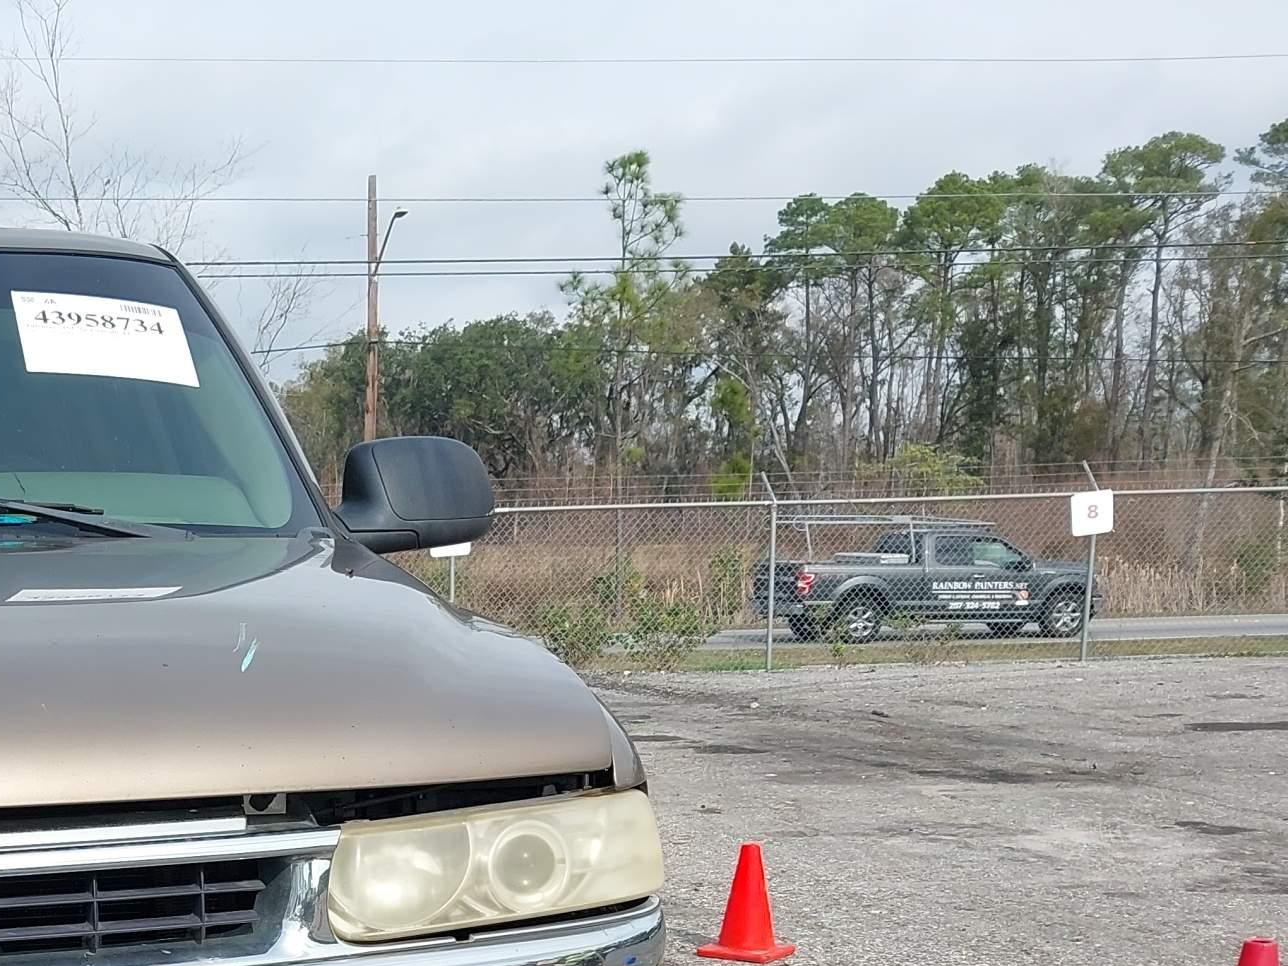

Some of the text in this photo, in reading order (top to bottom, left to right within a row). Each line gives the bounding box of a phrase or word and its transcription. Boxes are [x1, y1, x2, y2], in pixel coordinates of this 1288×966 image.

[33, 309, 165, 335] 43958734
[1088, 504, 1099, 519] 8
[932, 581, 973, 590] RAINBOW
